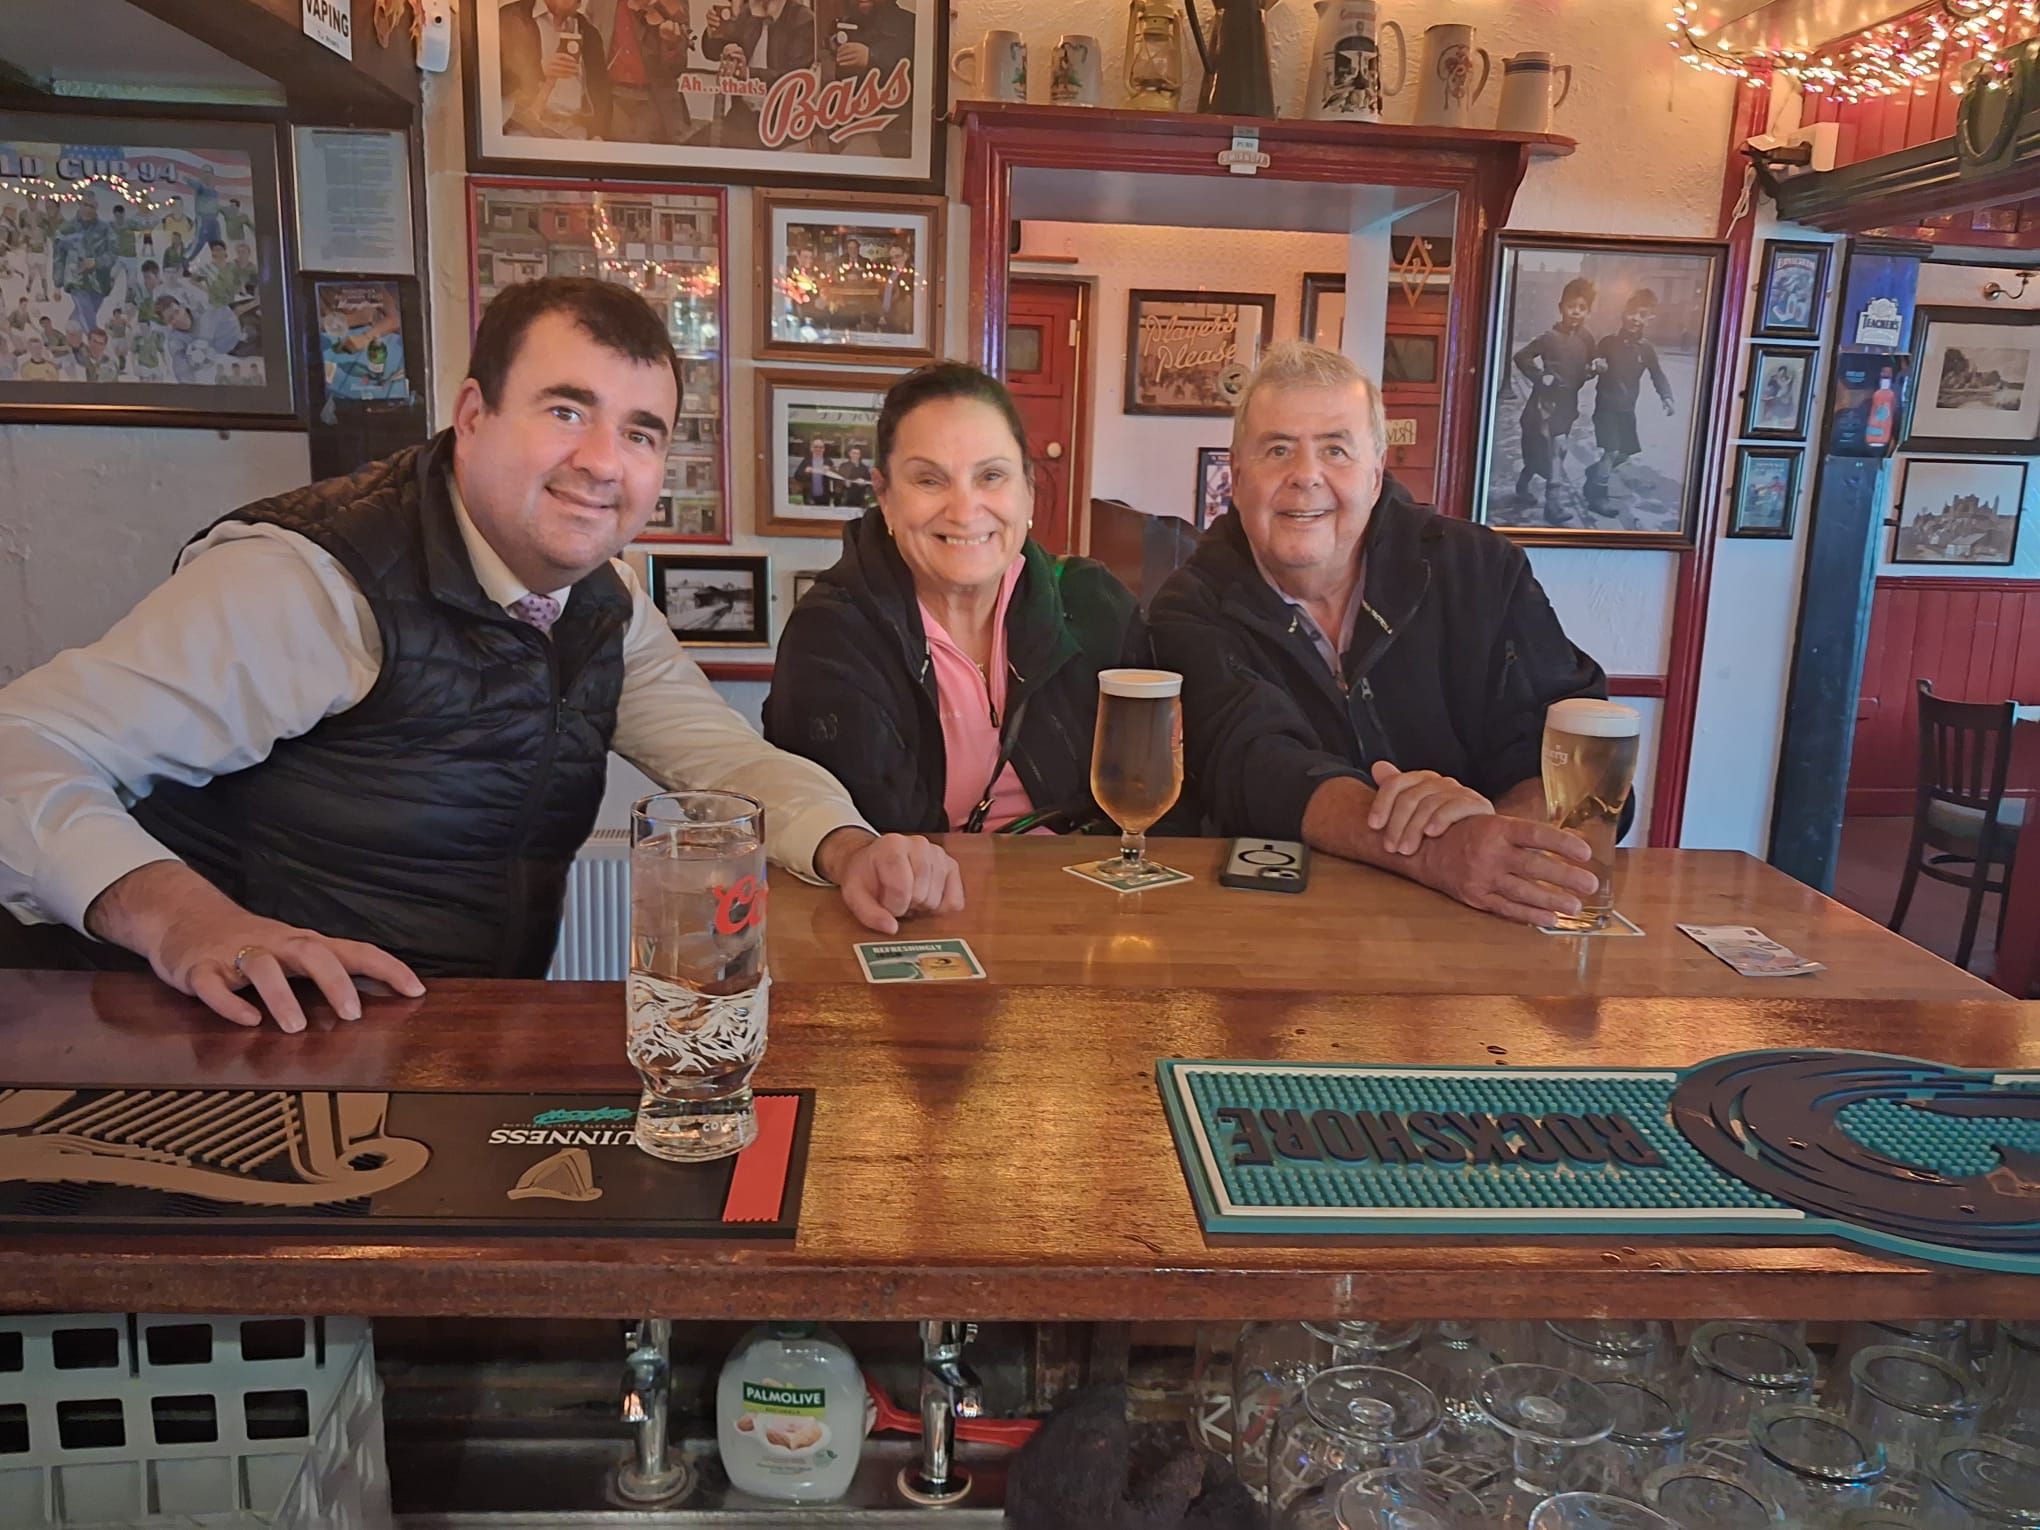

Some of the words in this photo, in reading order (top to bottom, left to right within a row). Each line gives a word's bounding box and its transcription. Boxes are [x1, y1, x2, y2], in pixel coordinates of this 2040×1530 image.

[306, 0, 350, 38] VAPING
[759, 57, 911, 147] Bass
[56, 157, 131, 181] CUP
[137, 161, 177, 183] 94
[1155, 340, 1238, 383] Please
[488, 1129, 637, 1146] UINNESS
[1216, 1106, 1668, 1168] ROCKSHORE
[745, 1386, 822, 1405] PALMOLIVE
